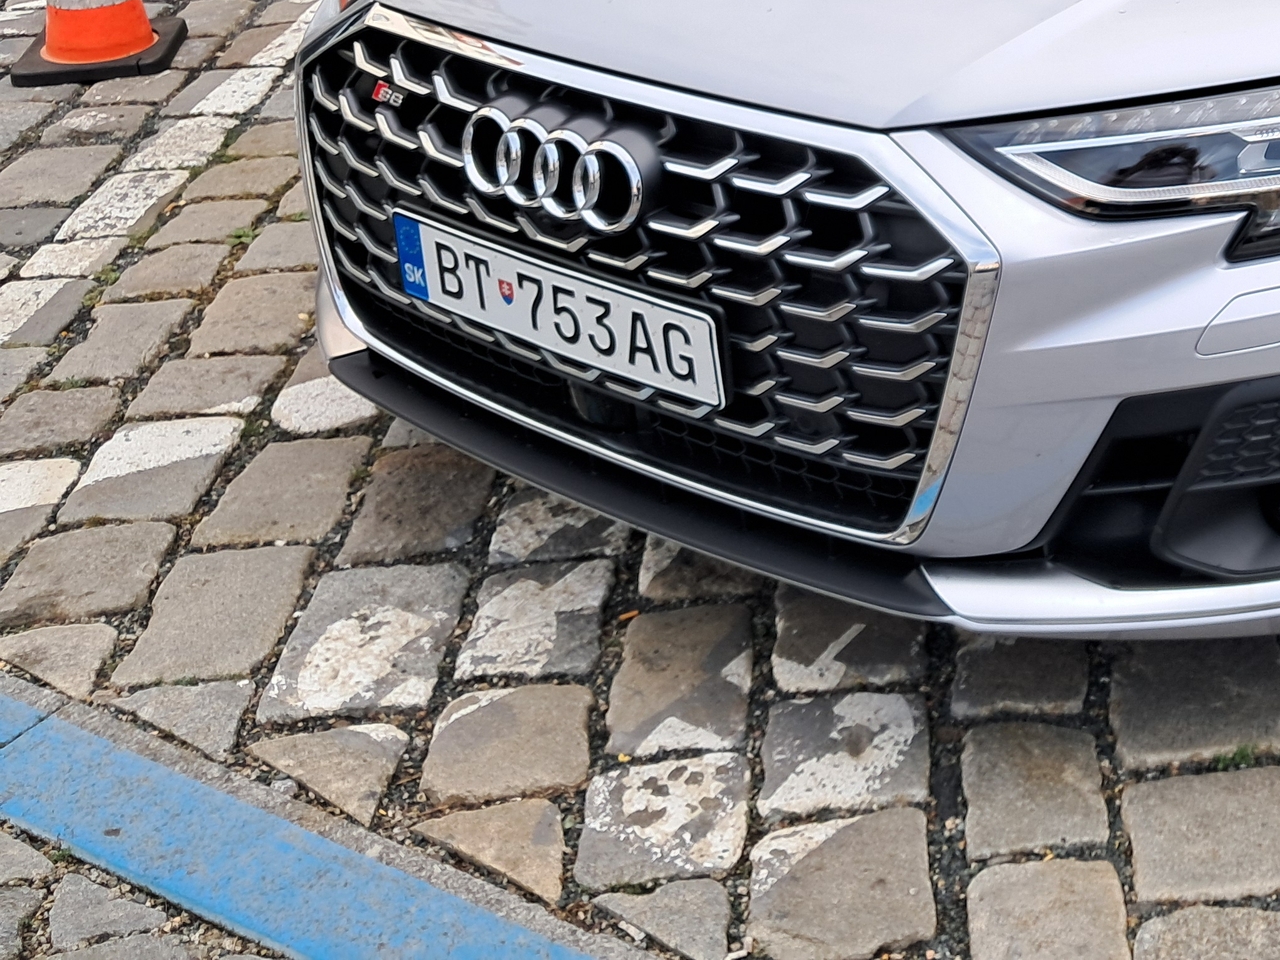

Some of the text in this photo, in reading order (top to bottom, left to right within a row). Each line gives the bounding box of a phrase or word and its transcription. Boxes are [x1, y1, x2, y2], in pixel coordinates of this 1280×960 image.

[377, 86, 404, 108] S8
[404, 261, 426, 288] SK
[434, 240, 491, 311] BT
